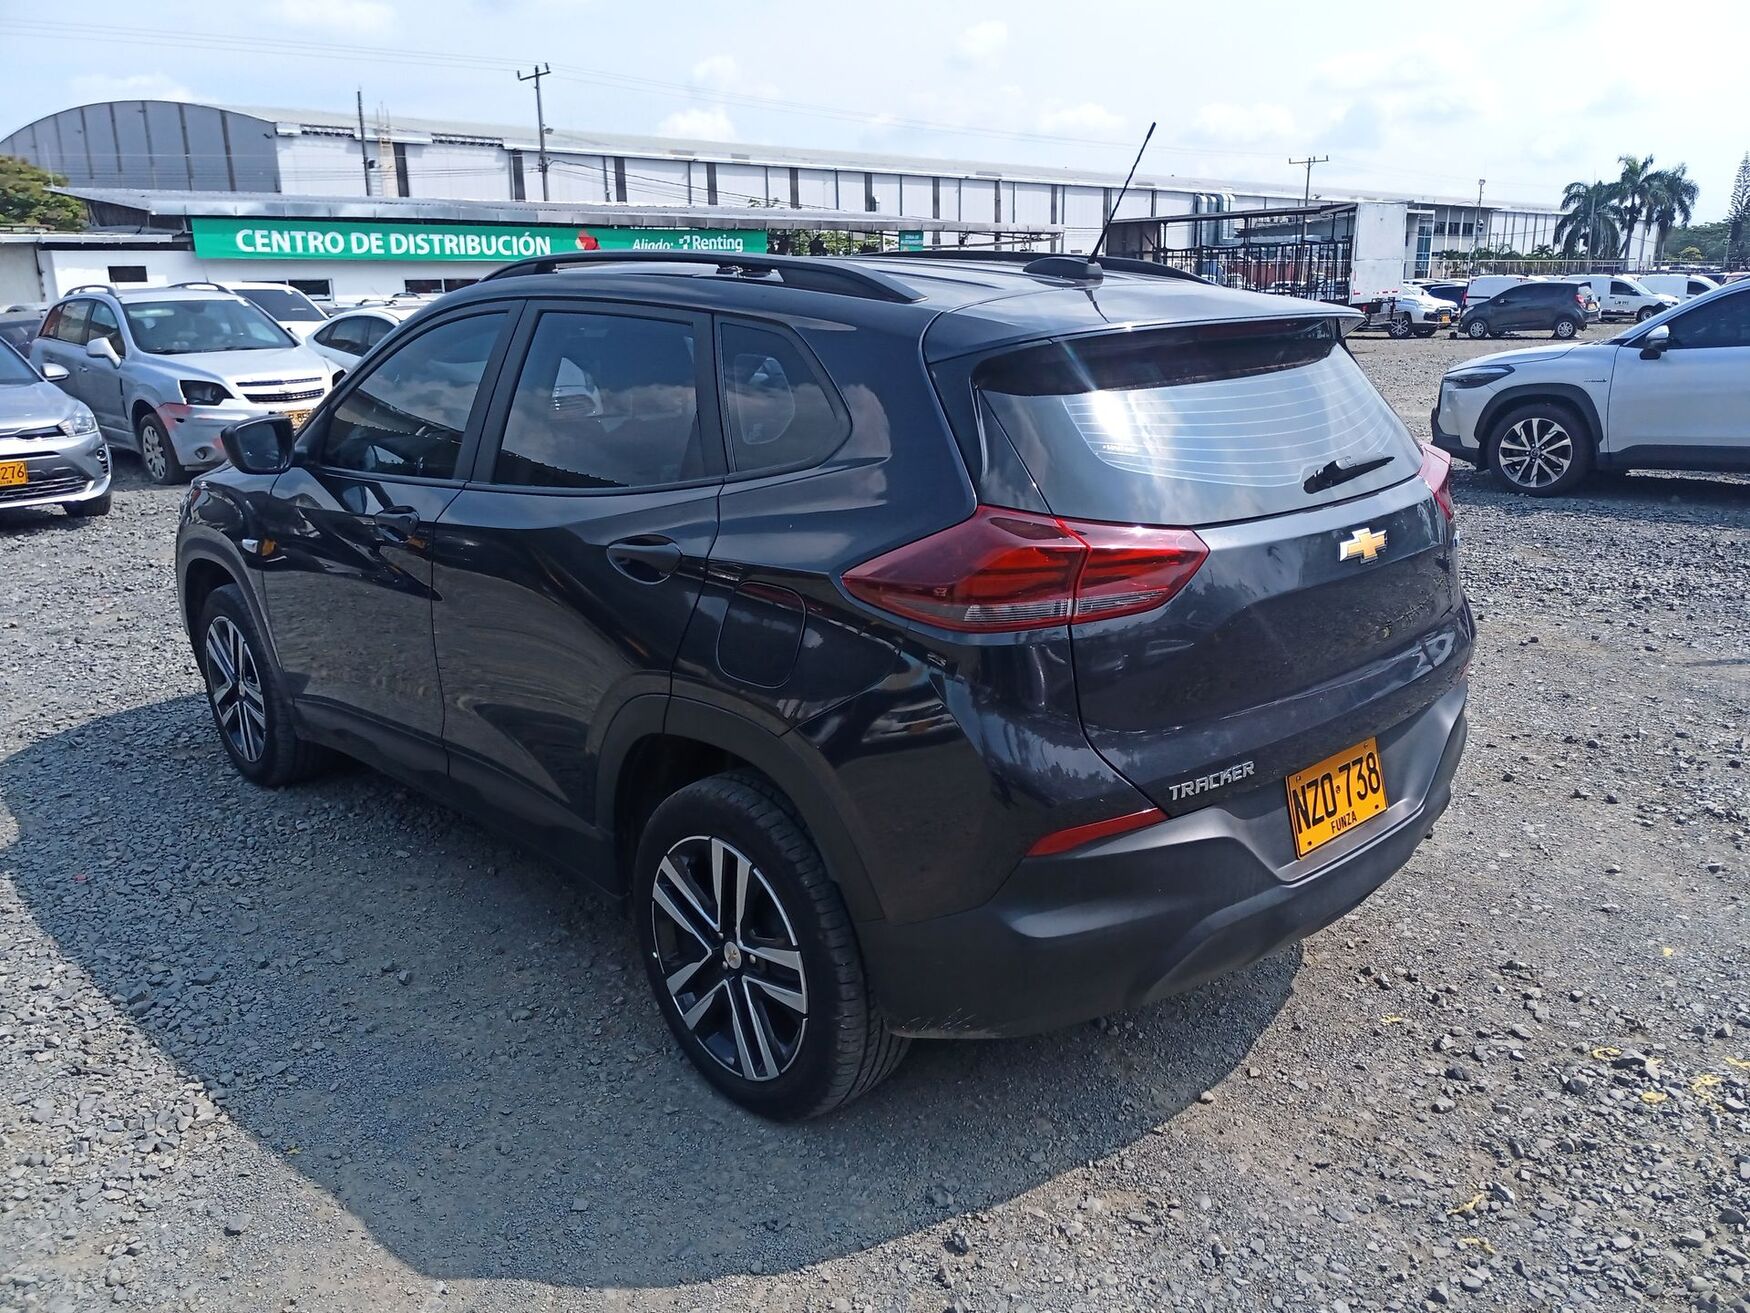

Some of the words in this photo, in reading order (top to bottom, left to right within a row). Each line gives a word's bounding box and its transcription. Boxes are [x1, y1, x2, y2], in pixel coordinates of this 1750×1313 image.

[235, 228, 345, 254] CENTRO
[351, 232, 385, 255] DE
[390, 231, 551, 256] DISTRIBUCIÓN
[692, 234, 744, 253] Renting
[1168, 760, 1255, 801] TRACKER
[1330, 810, 1358, 834] FUNZA
